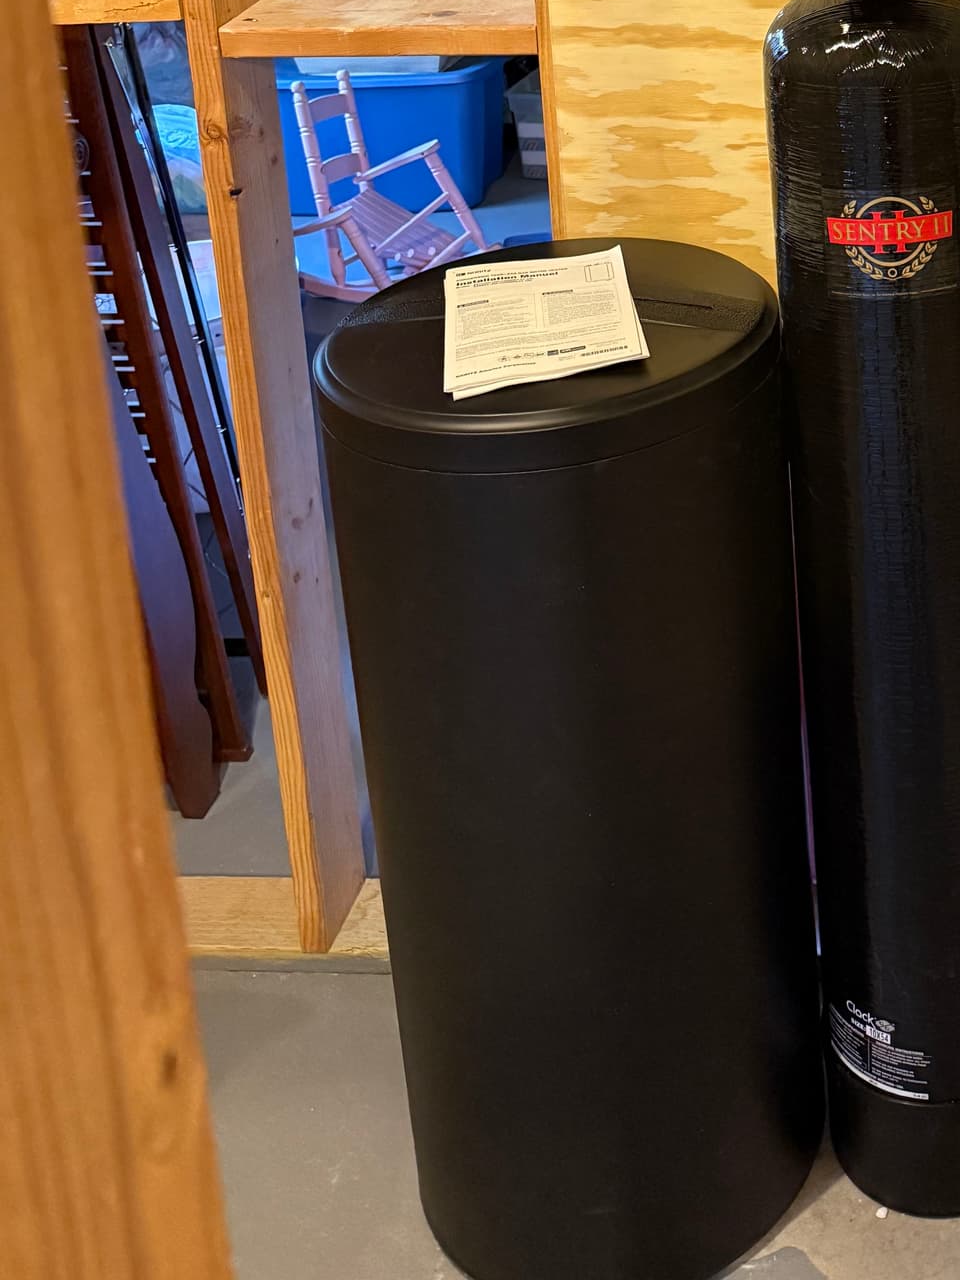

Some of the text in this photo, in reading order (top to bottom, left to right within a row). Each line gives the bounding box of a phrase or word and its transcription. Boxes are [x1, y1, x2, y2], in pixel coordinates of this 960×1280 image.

[832, 215, 950, 242] SENTRY II
[456, 271, 559, 286] Installation Manual
[846, 1000, 875, 1027] Clack
[868, 1027, 890, 1044] 10X54
